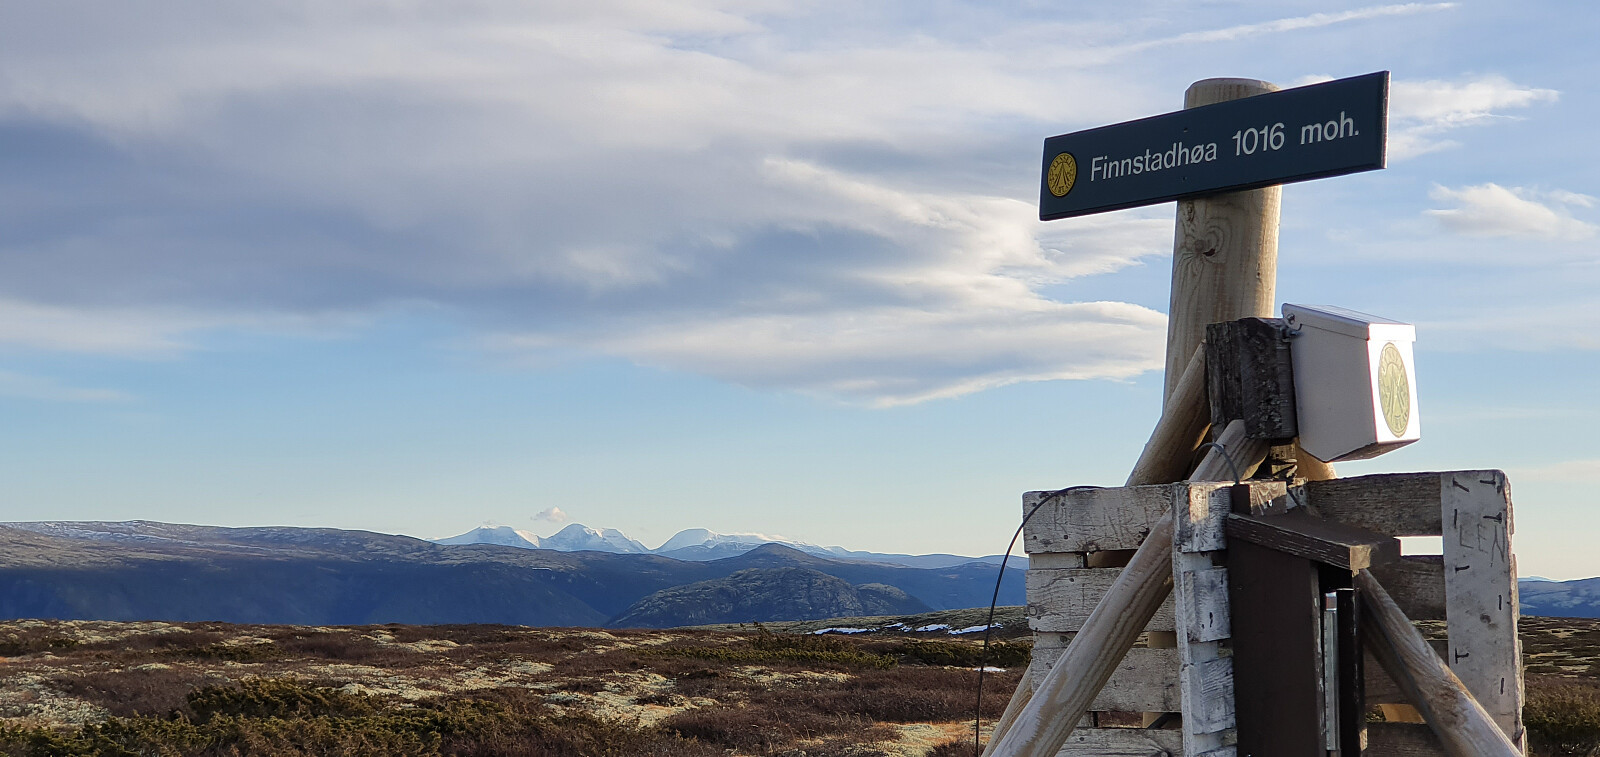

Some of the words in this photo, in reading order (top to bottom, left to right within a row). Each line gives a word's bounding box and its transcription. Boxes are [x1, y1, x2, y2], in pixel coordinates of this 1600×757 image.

[1090, 142, 1218, 182] Finnstadhøa
[1232, 122, 1286, 156] 1016
[1300, 111, 1360, 145] moh.
